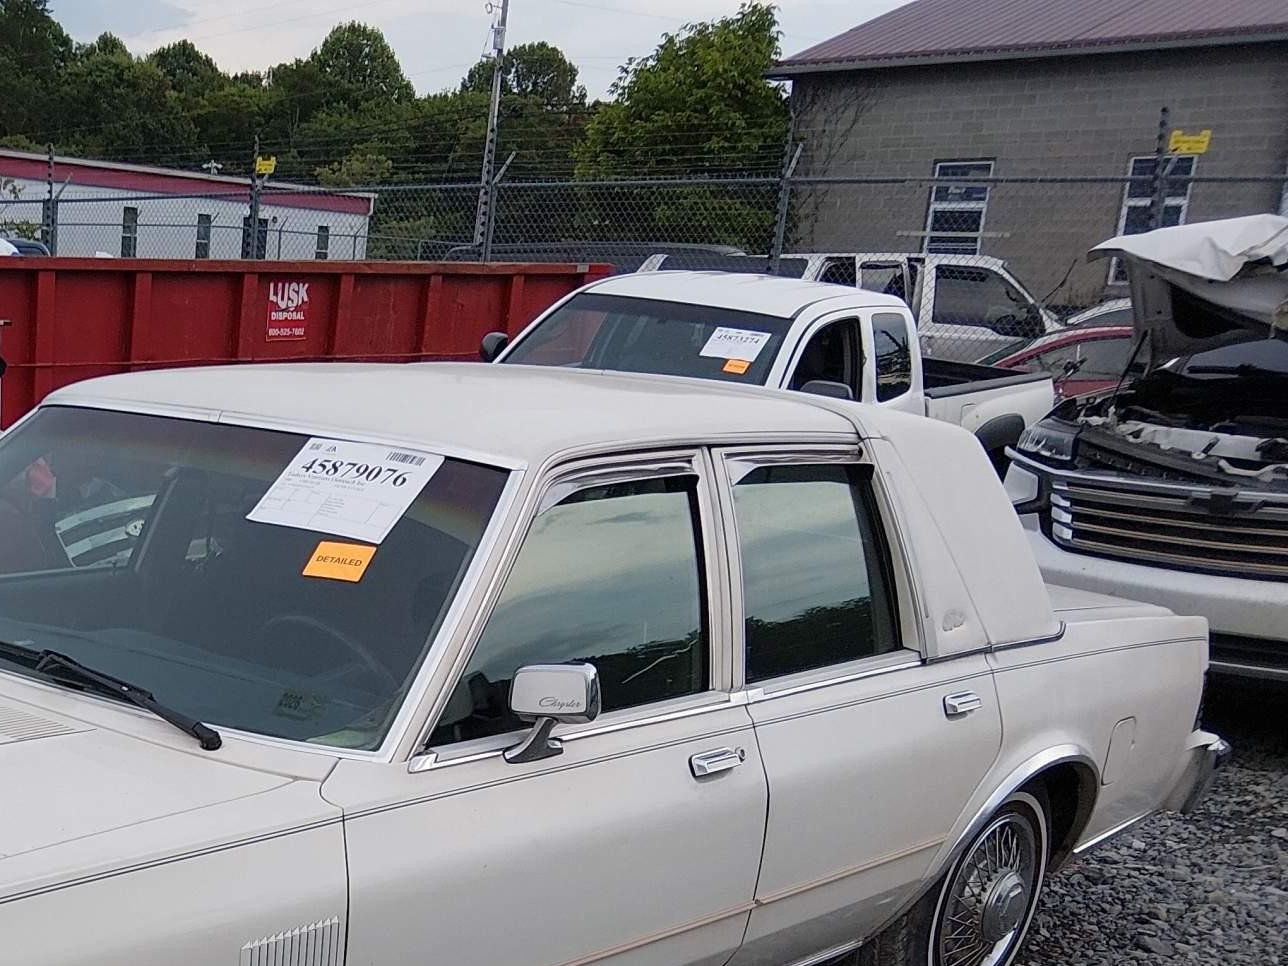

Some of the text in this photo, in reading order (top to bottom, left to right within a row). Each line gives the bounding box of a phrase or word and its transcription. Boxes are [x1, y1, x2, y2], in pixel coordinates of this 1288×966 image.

[269, 282, 309, 309] LUSK
[271, 311, 305, 321] DISPOSAL
[301, 457, 413, 488] 45879076
[315, 555, 362, 567] DETAILED
[538, 696, 581, 710] Chrysler
